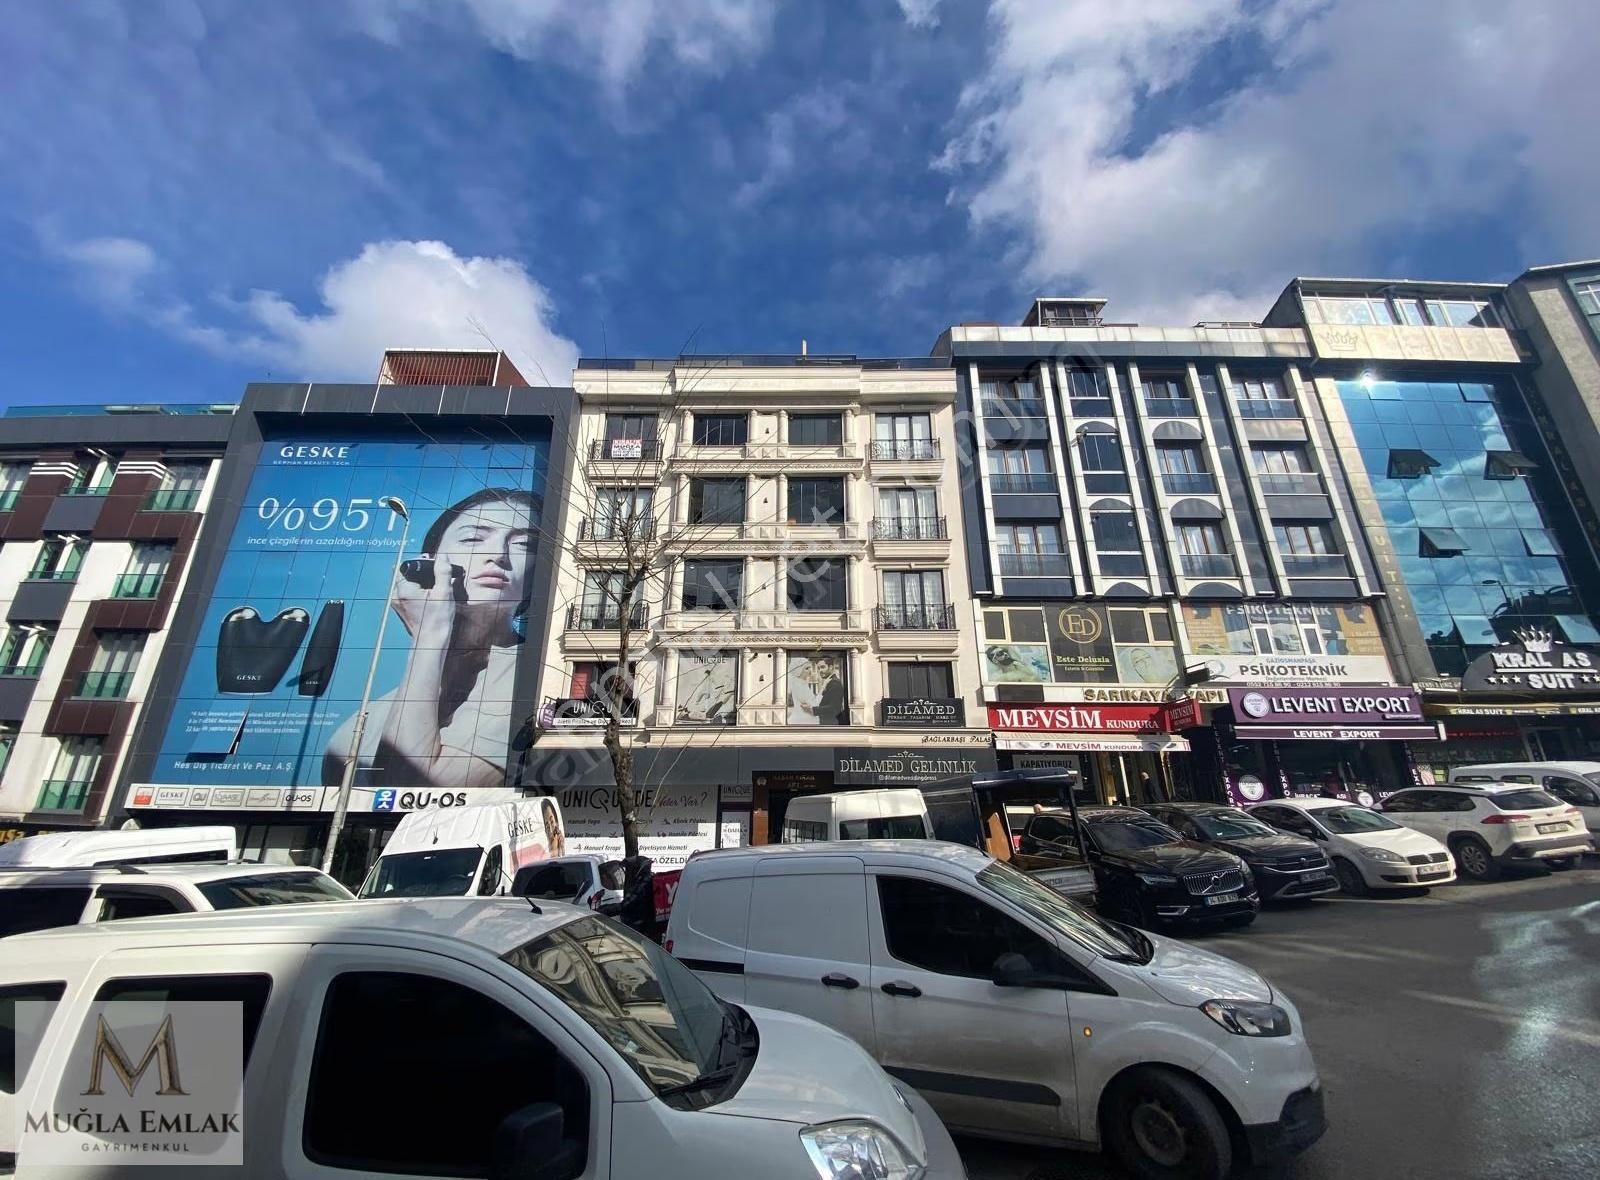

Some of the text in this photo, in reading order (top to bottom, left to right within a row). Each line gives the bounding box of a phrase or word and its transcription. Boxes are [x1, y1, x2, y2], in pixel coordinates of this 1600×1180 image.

[280, 446, 349, 459] GESKE
[247, 537, 268, 546] ince
[269, 537, 314, 547] çizgilerin
[1067, 614, 1096, 636] ED
[1056, 655, 1075, 663] Este
[1491, 652, 1592, 668] KRAL AS
[1239, 663, 1348, 676] PSİKOTEKNİK
[887, 703, 955, 715] DİLAMED
[1272, 696, 1410, 713] LEVENT EXPORT
[996, 706, 1160, 729] MEVSİM KUNDURA
[1293, 730, 1380, 738] LEVENT EXPORT
[1056, 742, 1101, 750] MEVSİM
[840, 757, 977, 774] DİLAMED GELİNLİK
[400, 792, 467, 809] QU-OS
[507, 817, 534, 839] GESKE
